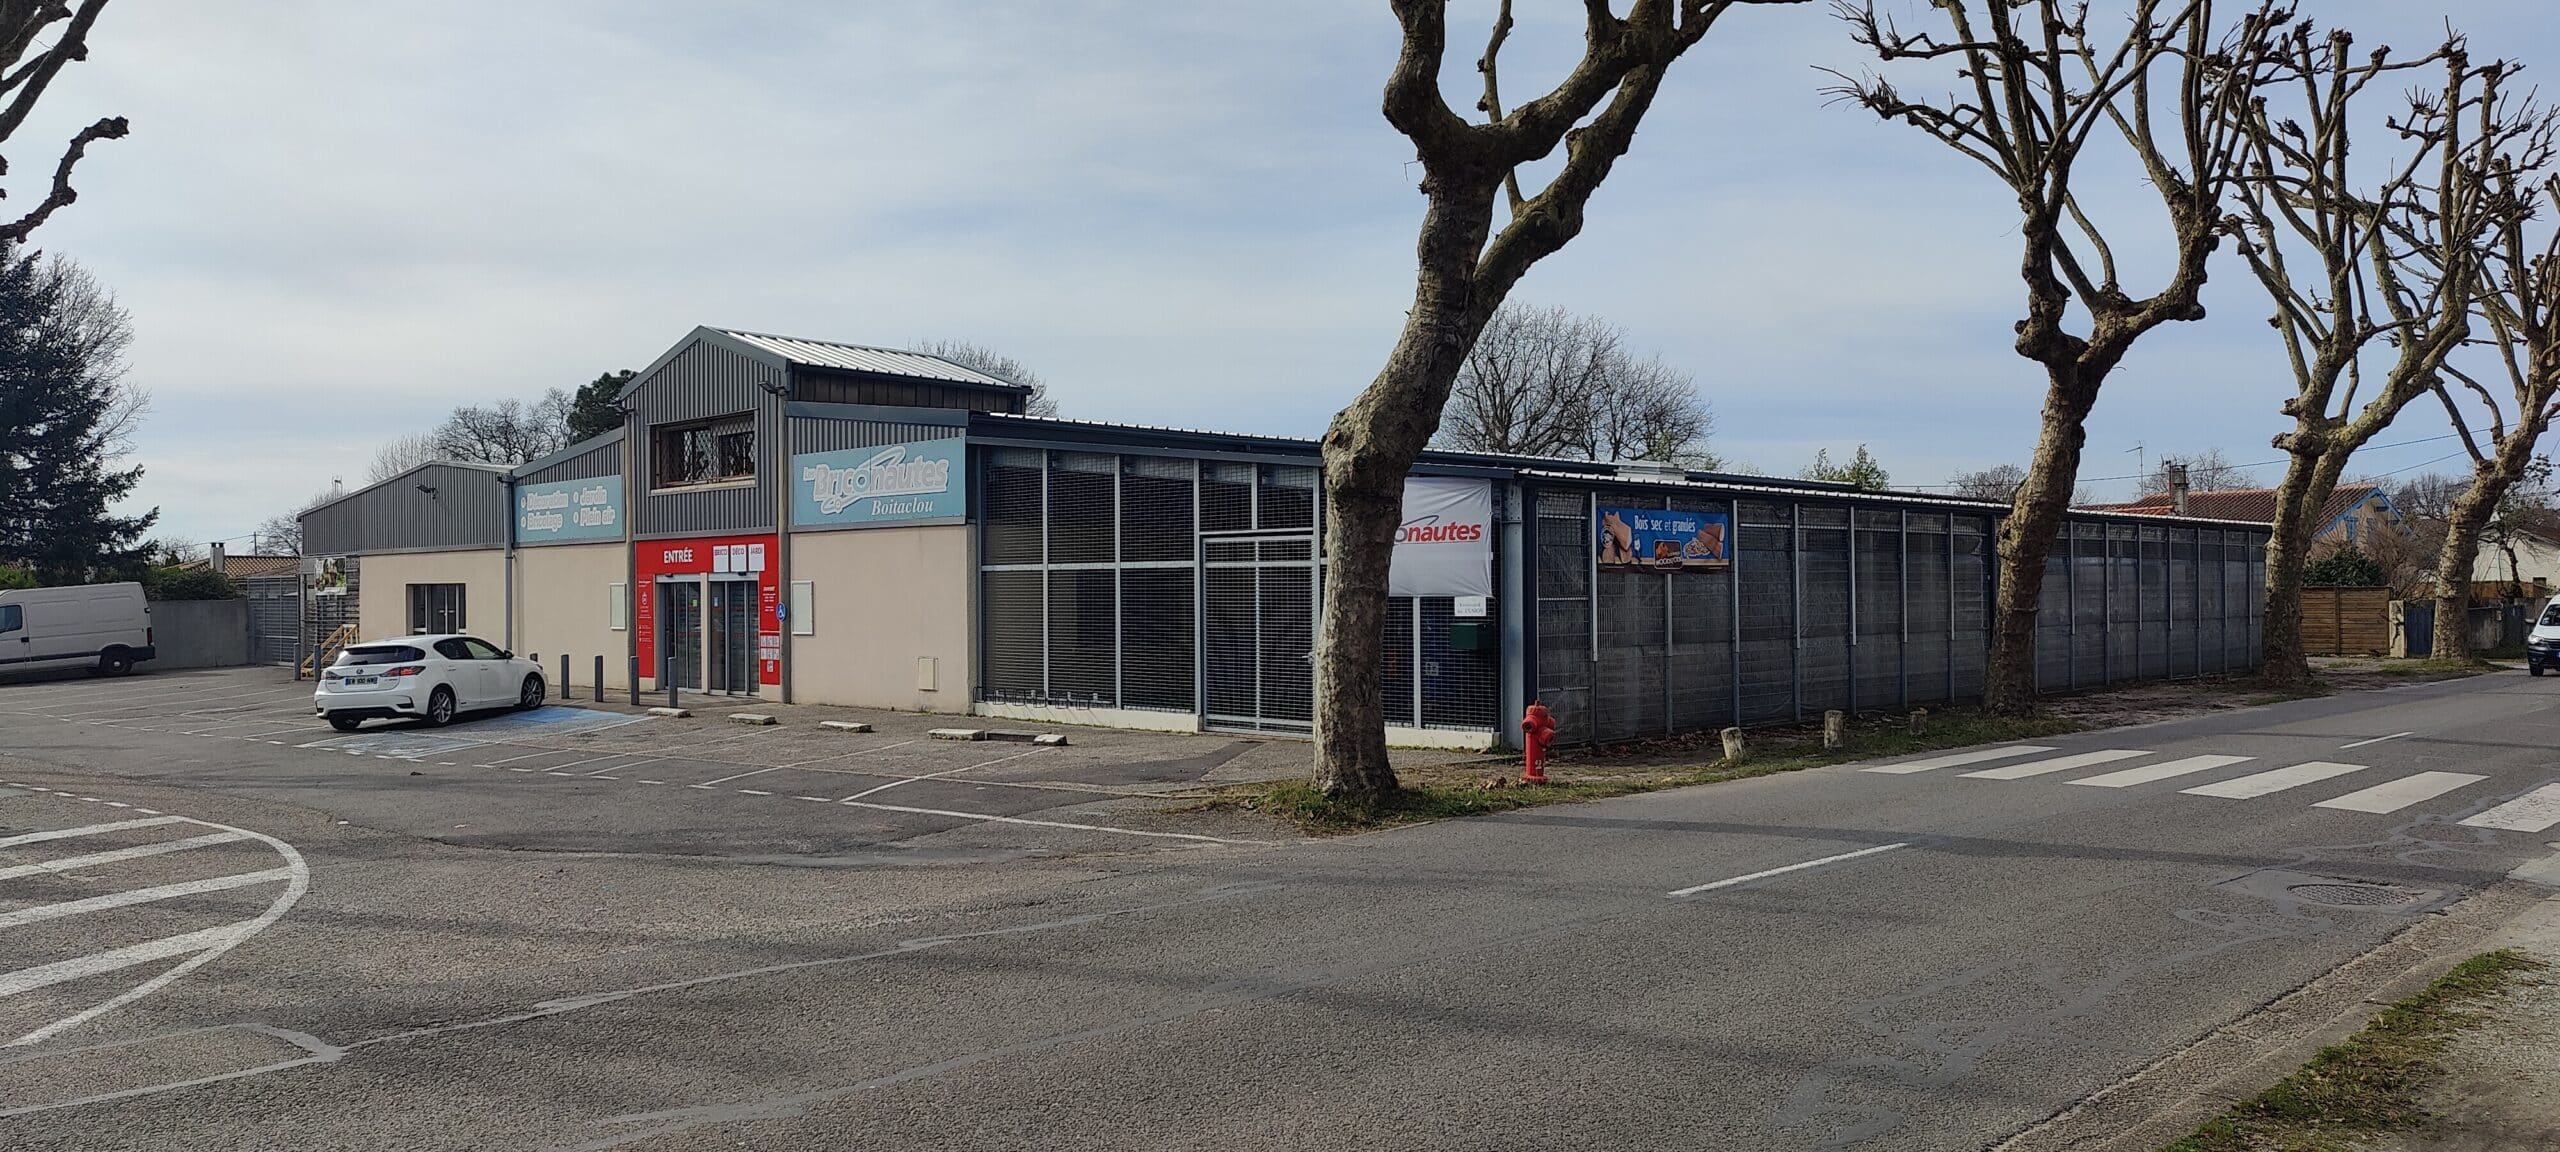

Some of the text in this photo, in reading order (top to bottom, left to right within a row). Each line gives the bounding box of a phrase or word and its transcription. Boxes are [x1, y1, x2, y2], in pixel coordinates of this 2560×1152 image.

[815, 456, 948, 498] Briconautes
[872, 498, 934, 516] Boitaclou
[1394, 521, 1482, 543] onautes
[1634, 515, 1696, 535] Bois sec et granulés
[663, 547, 693, 563] ENTRÉE
